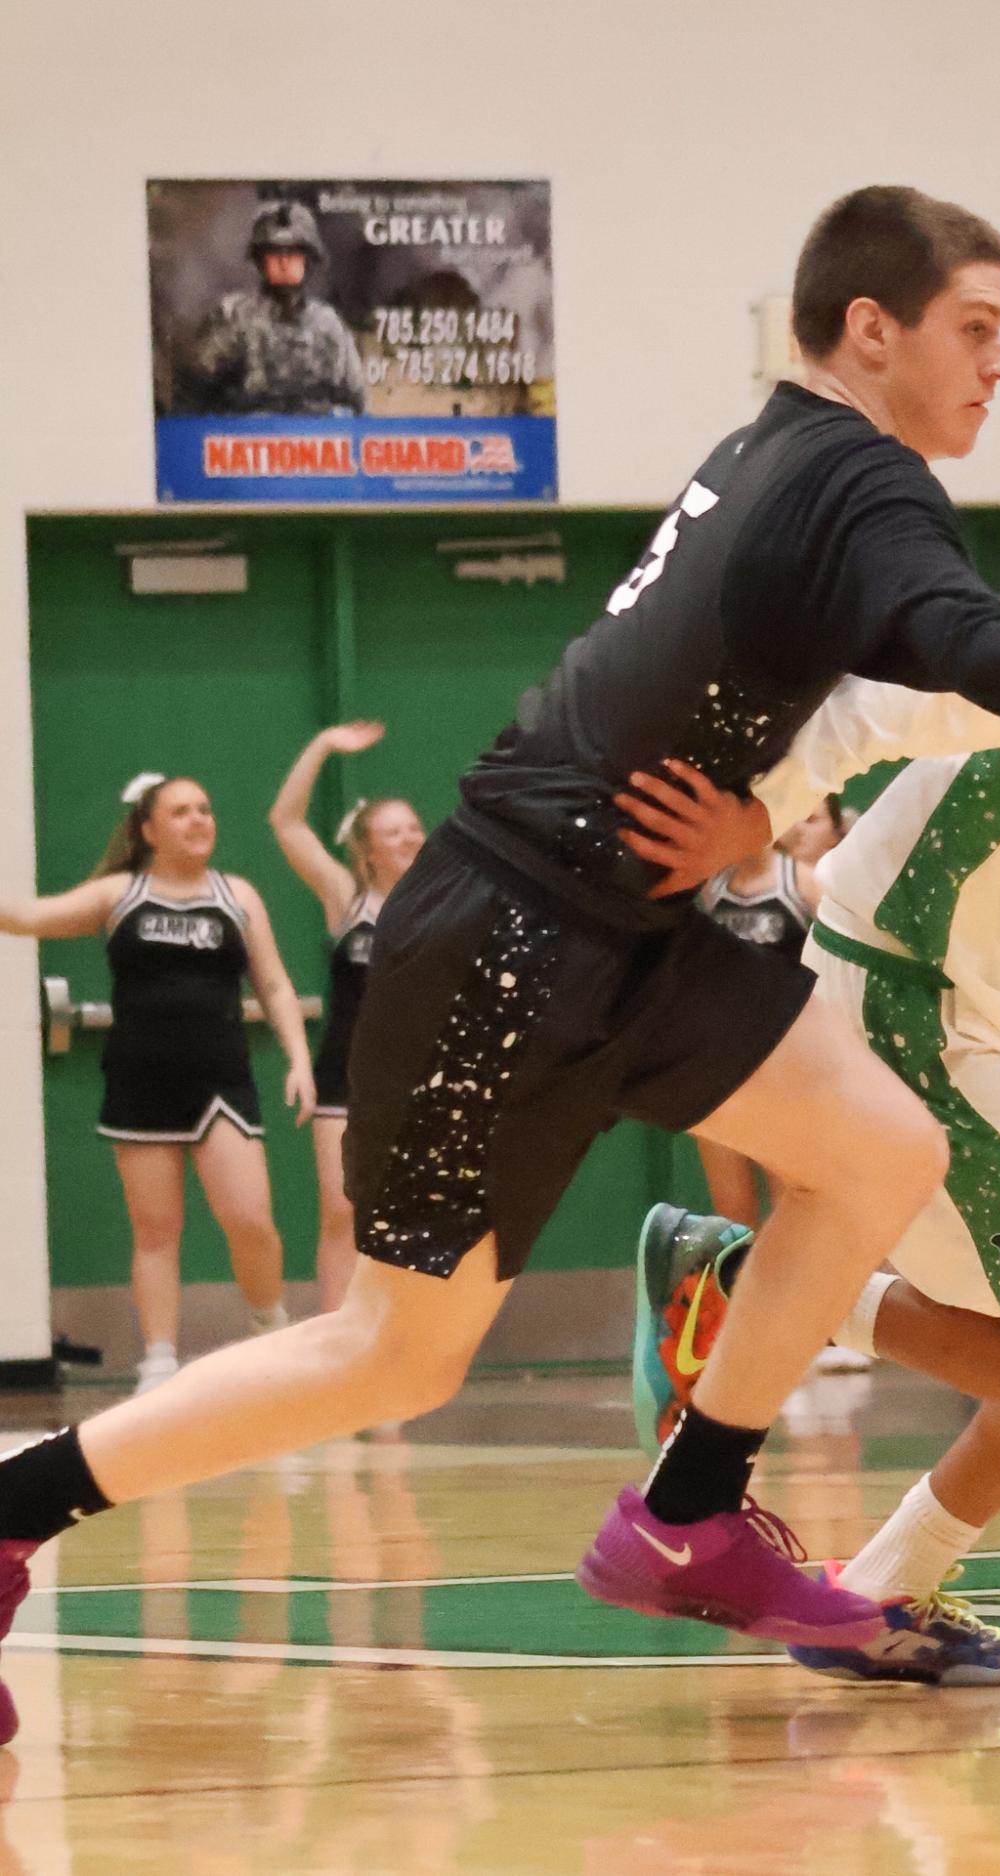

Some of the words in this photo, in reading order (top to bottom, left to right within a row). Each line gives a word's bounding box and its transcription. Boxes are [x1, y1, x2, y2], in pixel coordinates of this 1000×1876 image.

[364, 216, 505, 246] GREATER
[367, 357, 390, 385] or
[204, 434, 357, 477] NATIONAL
[361, 434, 466, 477] GUARD
